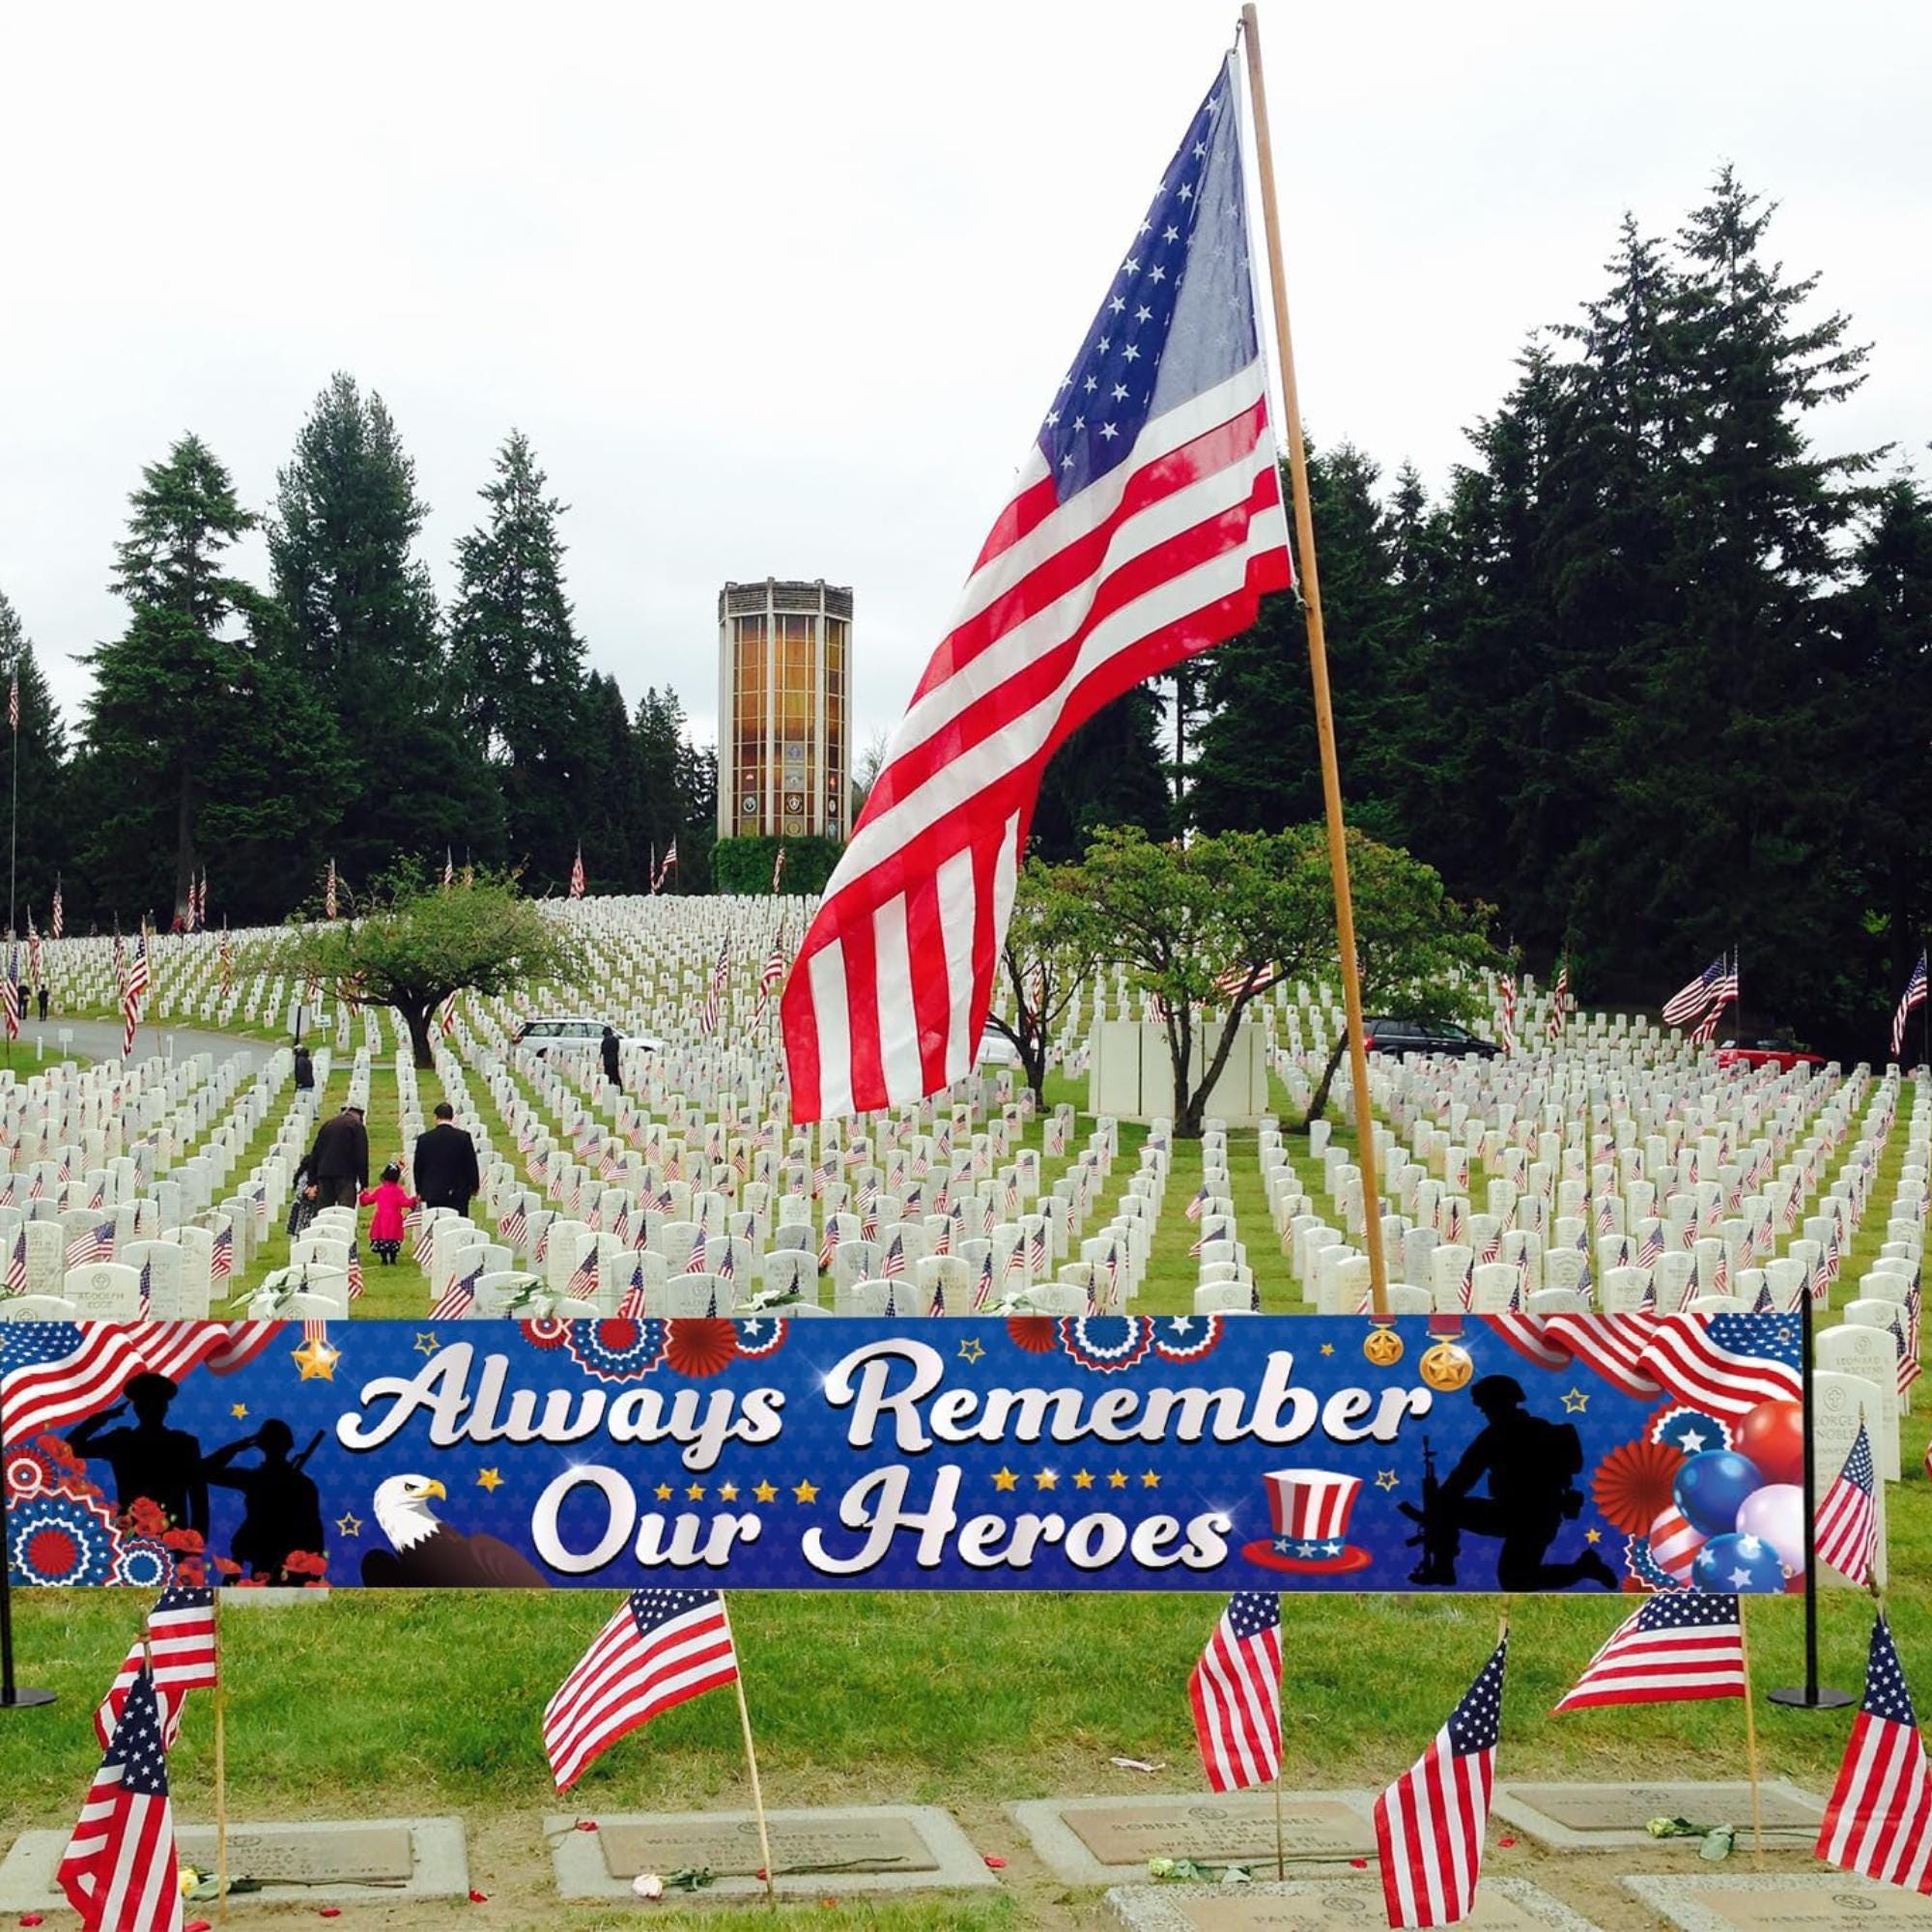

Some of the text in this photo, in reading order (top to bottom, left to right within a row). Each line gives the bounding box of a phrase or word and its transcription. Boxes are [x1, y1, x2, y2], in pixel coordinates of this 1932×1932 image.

[336, 1337, 1432, 1470] Always Remember
[531, 1463, 1233, 1575] Our Heroes
